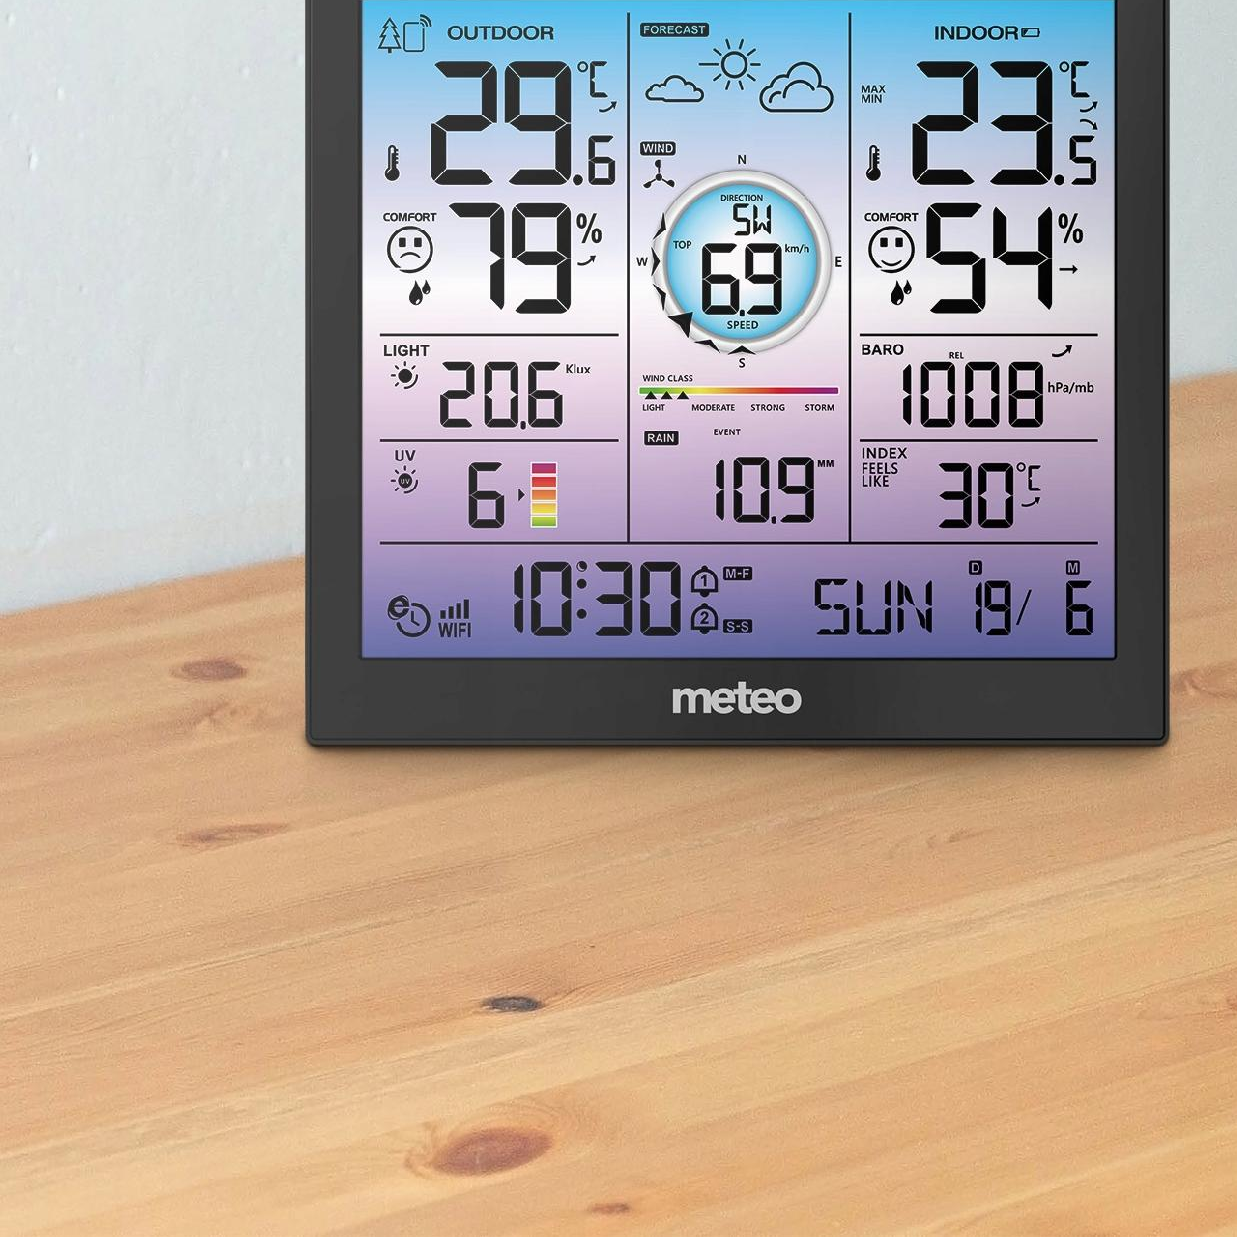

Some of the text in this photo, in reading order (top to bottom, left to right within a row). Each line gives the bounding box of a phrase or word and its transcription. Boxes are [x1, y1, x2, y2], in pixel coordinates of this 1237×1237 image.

[447, 25, 554, 41] OUTDOOR
[642, 25, 707, 35] FORECAST
[934, 25, 1019, 41] INDOOR
[861, 84, 886, 94] MAX
[861, 94, 883, 104] MIN
[431, 60, 616, 186] 29.6
[912, 60, 1097, 186] 23.5
[642, 142, 675, 153] WIND
[737, 154, 747, 165] N
[720, 194, 764, 202] DIRECTION
[383, 212, 437, 222] COMFORT
[732, 203, 772, 236] SW
[864, 212, 919, 222] COMFORT
[673, 240, 692, 249] TOP
[448, 202, 603, 314] 79 %
[636, 257, 648, 267] W
[834, 256, 842, 267] E
[926, 202, 1084, 314] 54 %
[701, 242, 782, 317] 6.9
[727, 320, 759, 330] SPEED
[383, 344, 430, 357] LIGHT
[861, 344, 904, 356] BARO
[948, 351, 964, 360] REL
[738, 358, 746, 368] S
[642, 374, 693, 382] WIND CLASS
[439, 361, 591, 430] 20.6 Klux
[902, 361, 1094, 428] 1008 hPa/mb
[642, 404, 835, 412] LIGHT MODERATE STRONG STORM
[646, 433, 675, 443] RAIN
[395, 450, 416, 461] UV
[862, 447, 907, 459] INDEX
[862, 462, 898, 474] FEELS
[862, 475, 890, 487] LIKE
[468, 462, 505, 528] 6
[715, 457, 814, 524] 10.9
[938, 462, 1014, 528] 30
[724, 568, 750, 579] M-F
[971, 562, 979, 573] D
[1067, 562, 1078, 573] M
[513, 561, 682, 636] 10:30
[814, 578, 933, 635] SUN
[1065, 580, 1094, 636] 6
[438, 623, 471, 638] WIFI
[725, 621, 749, 633] S-S
[672, 681, 802, 714] meteo
